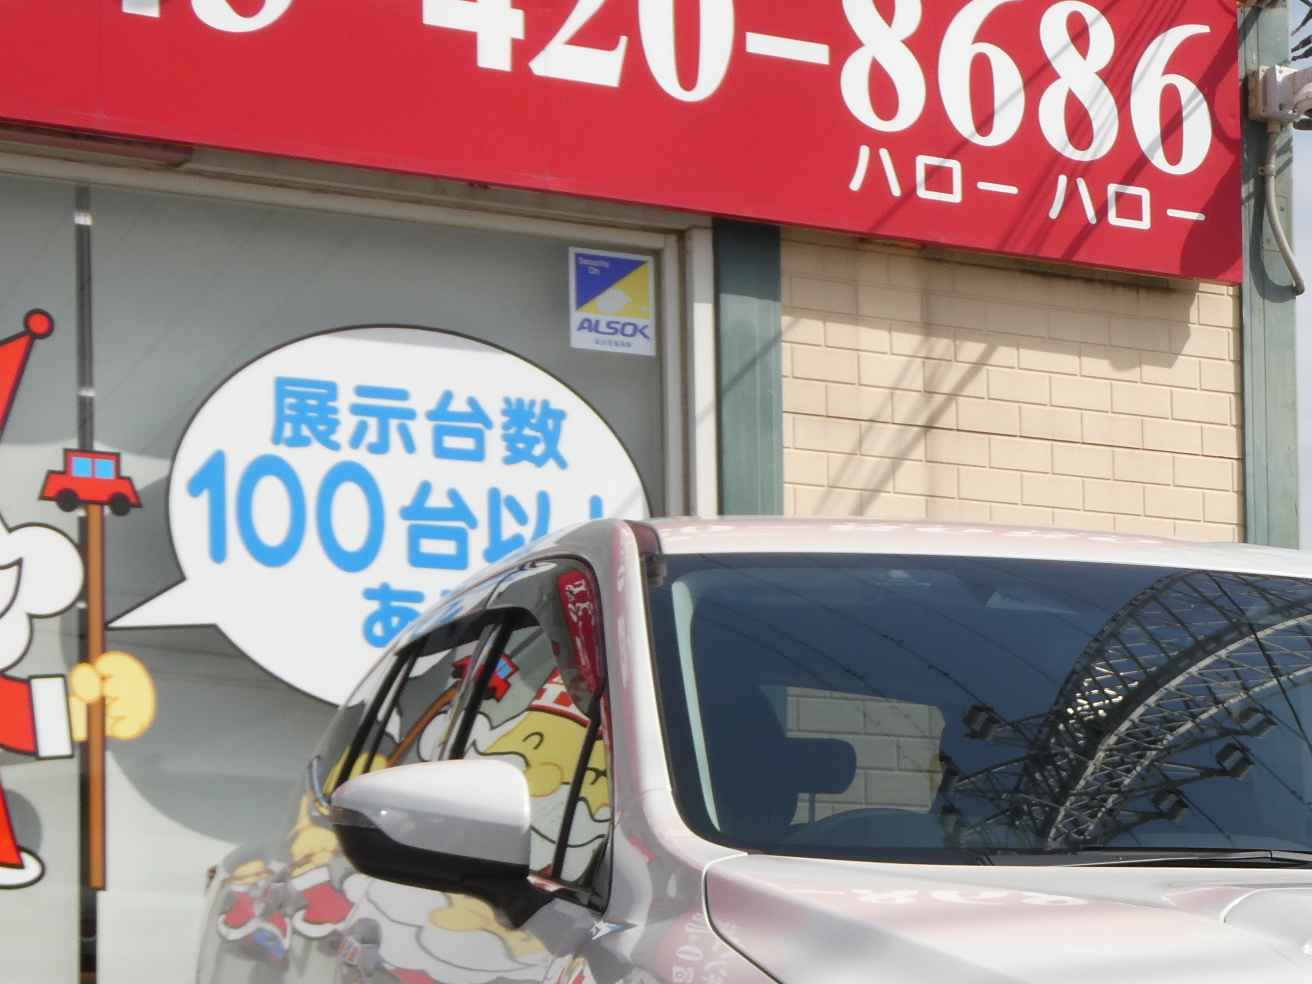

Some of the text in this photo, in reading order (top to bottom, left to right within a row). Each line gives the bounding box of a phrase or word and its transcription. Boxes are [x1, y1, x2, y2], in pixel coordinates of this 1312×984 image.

[849, 144, 1206, 230] ハロー ハロー
[577, 318, 650, 340] ALSOK
[271, 376, 568, 471] 展示台数
